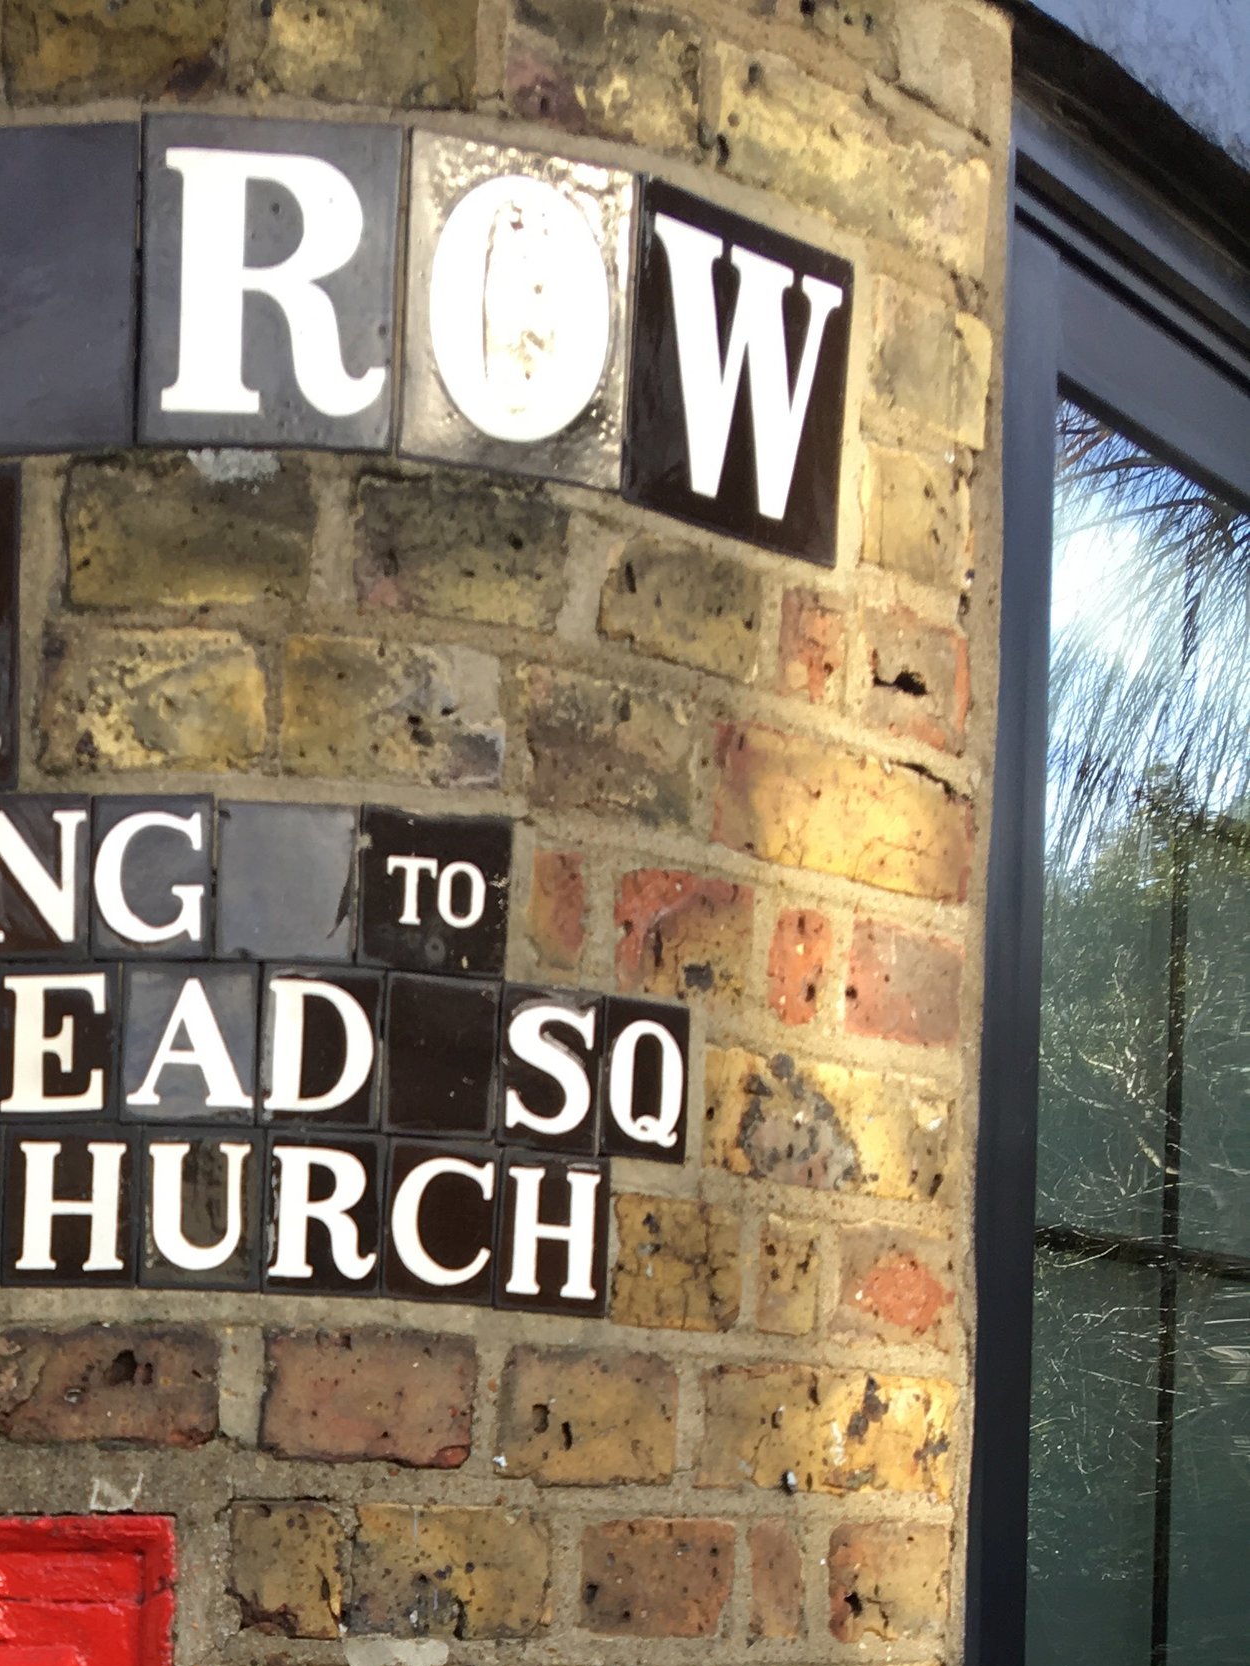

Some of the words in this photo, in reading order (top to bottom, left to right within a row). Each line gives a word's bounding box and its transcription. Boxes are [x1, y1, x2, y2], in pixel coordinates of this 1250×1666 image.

[161, 146, 843, 521] ROW
[387, 856, 486, 928] TO
[506, 1005, 684, 1148] SQ
